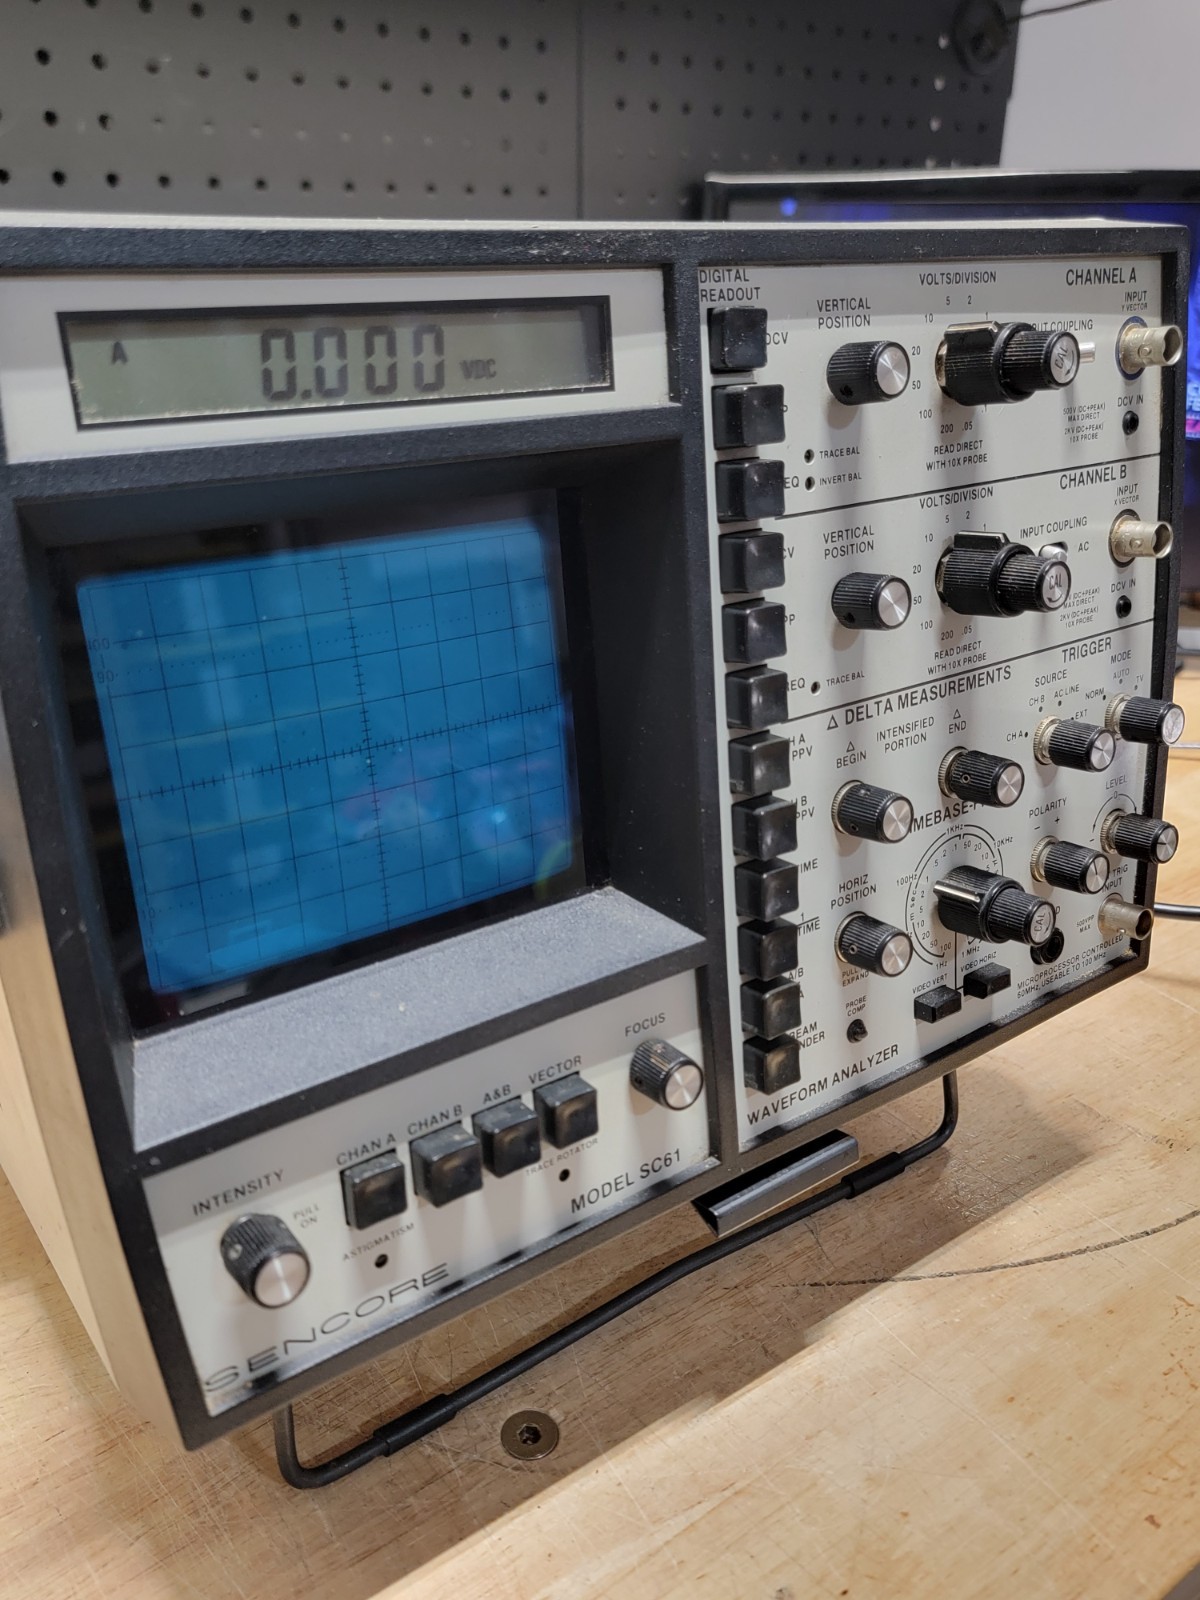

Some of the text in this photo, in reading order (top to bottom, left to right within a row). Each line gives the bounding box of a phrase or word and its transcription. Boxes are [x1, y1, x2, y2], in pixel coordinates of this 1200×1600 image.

[699, 269, 749, 283] DIGITAL
[919, 272, 996, 285] VOLTS/DIVISION
[1066, 267, 1136, 286] CHANNEL A
[700, 287, 760, 302] READOUT
[946, 295, 972, 305] 5 2
[1125, 291, 1147, 301] INPUT
[817, 298, 871, 312] VERTICAL
[1126, 303, 1147, 311] VECTOR
[818, 315, 871, 329] POSITION
[924, 313, 933, 323] 10
[1051, 319, 1093, 331] COUPLING
[111, 341, 127, 365] A
[912, 347, 920, 355] 20
[260, 324, 445, 400] 0.000
[1054, 347, 1069, 370] CAL
[460, 359, 496, 381] VDC
[912, 380, 921, 389] 50
[1117, 395, 1143, 407] DCV IN
[919, 410, 932, 419] 100
[941, 424, 953, 433] 200
[1081, 432, 1098, 440] PROBE
[820, 447, 860, 459] TRACE BAL
[934, 440, 983, 455] READ DIRECT
[926, 453, 987, 471] WITH 10X PROBE
[820, 473, 862, 485] INVERT BAL
[1060, 465, 1126, 489] CHANNEL B
[1117, 484, 1138, 496] INPUT
[920, 486, 993, 509] VOLTS/DIVISION
[1119, 495, 1139, 504] VECTOR
[945, 511, 970, 523] 5 2
[823, 525, 874, 544] VERTICAL
[1020, 516, 1087, 539] INPUT COUPLING
[925, 533, 933, 542] 10
[824, 540, 874, 560] POSITION
[1078, 542, 1089, 552] AC
[913, 565, 921, 574] 20
[1049, 574, 1062, 589] CAL
[1111, 579, 1136, 592] DCV IN
[914, 596, 922, 605] 50
[921, 620, 933, 630] 100
[941, 630, 953, 640] 200
[935, 641, 982, 660] READ DIRECT
[1062, 637, 1112, 663] TRIGGER
[1111, 650, 1131, 664] MODE
[928, 652, 987, 675] WITH 10X PROBE
[826, 671, 865, 686] TRACE BAL
[1035, 669, 1067, 687] SOURCE
[1113, 668, 1130, 679] AUTO
[1136, 675, 1144, 683] TV
[845, 665, 1011, 725] DELTA MEASUREMENTS
[1054, 684, 1079, 698] AC LINE
[1086, 688, 1104, 700] NORM
[1029, 698, 1039, 706] CH
[1075, 709, 1087, 719] EXT
[877, 716, 934, 741] INTENSIFIED
[949, 720, 966, 734] END
[799, 733, 805, 743] A
[885, 732, 927, 753] PORTION
[1007, 730, 1023, 742] CH A
[792, 746, 812, 761] PPV
[836, 750, 866, 768] BEGIN
[1106, 775, 1127, 789] LEVEL
[802, 796, 807, 806] B
[1029, 798, 1067, 818] POLARITY
[964, 840, 971, 849] 50
[974, 843, 981, 851] 20
[1113, 864, 1128, 876] TRIG
[839, 874, 868, 893] HORIZ
[831, 884, 876, 909] POSITION
[801, 913, 804, 921] 1
[917, 920, 924, 928] 10
[1034, 912, 1045, 931] CAL
[922, 931, 930, 939] 20
[930, 940, 937, 948] 50
[941, 942, 951, 952] 100
[960, 952, 996, 972] VIDEO HORIZ
[1018, 934, 1124, 989] MICROPROCESSOR CONTROLLED
[842, 968, 857, 978] PULL
[1042, 968, 1070, 986] USEABLE
[1072, 962, 1080, 972] TO
[1082, 957, 1092, 968] 100
[843, 971, 869, 987] EXPAND
[912, 974, 948, 994] VIDEO VERT
[845, 995, 867, 1009] PROBE
[848, 1004, 865, 1016] COMP
[624, 1013, 666, 1036] FOCUS
[529, 1056, 582, 1084] VECTOR
[747, 1044, 898, 1125] WAVEFORM ANALYZER
[483, 1084, 511, 1104] A&B
[407, 1105, 462, 1135] CHAN B
[336, 1133, 396, 1166] CHAN A
[526, 1138, 598, 1176] TRACE ROTATOR
[571, 1149, 680, 1212] MODEL SC61
[193, 1169, 284, 1216] INTENSITY
[342, 1223, 415, 1261] ASTIGMATISM
[205, 1263, 449, 1392] SENCORE
